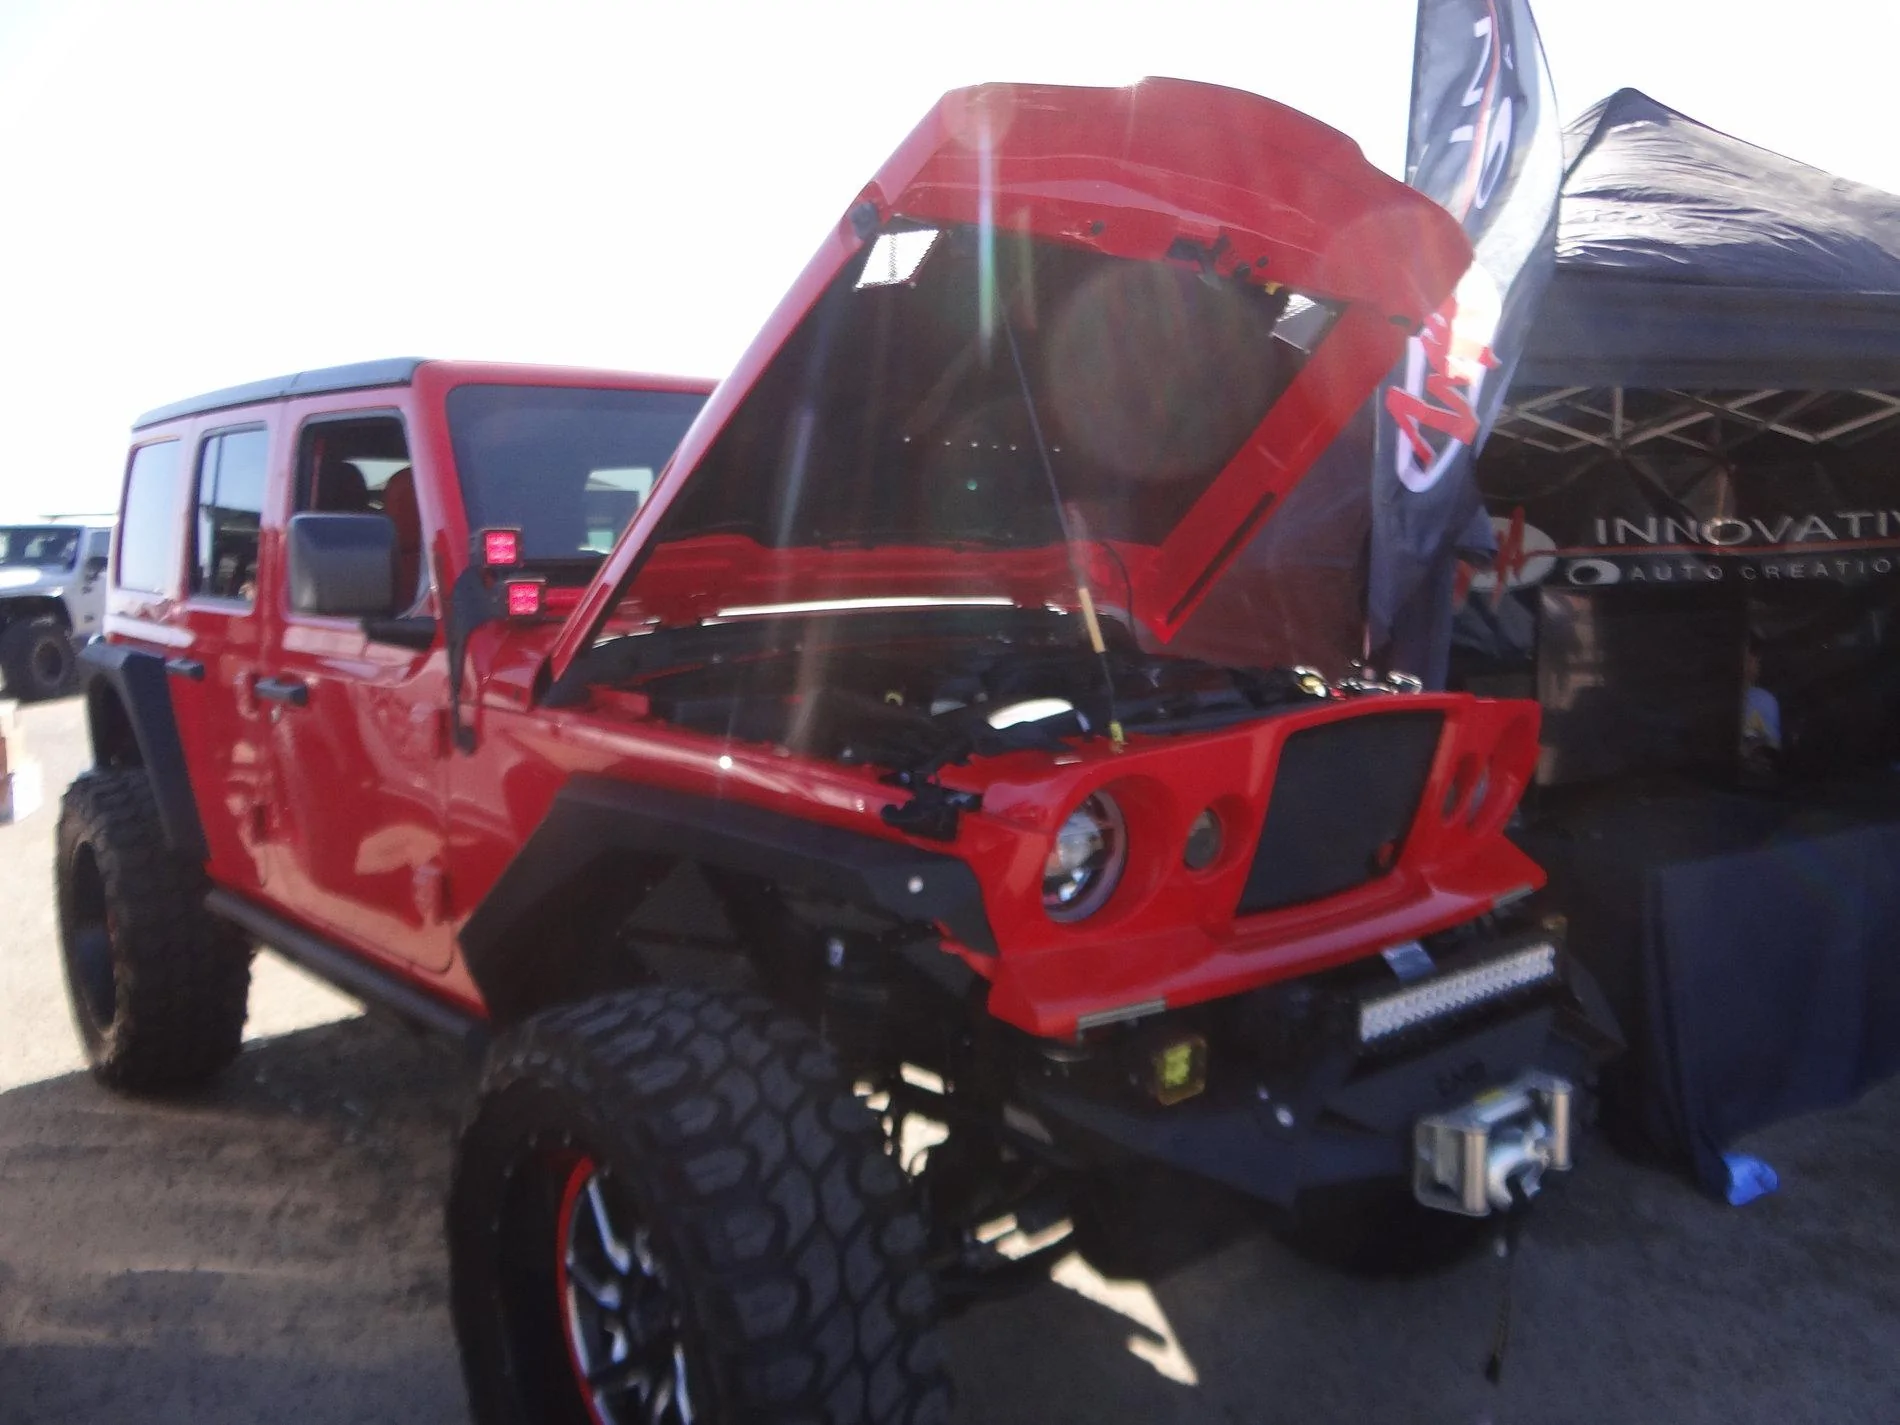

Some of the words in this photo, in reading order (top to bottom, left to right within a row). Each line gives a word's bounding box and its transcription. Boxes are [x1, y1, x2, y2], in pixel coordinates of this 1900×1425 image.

[1596, 510, 1900, 546] INNOVATI
[1629, 564, 1723, 581] AUTO
[1740, 557, 1900, 581] CREATIO
